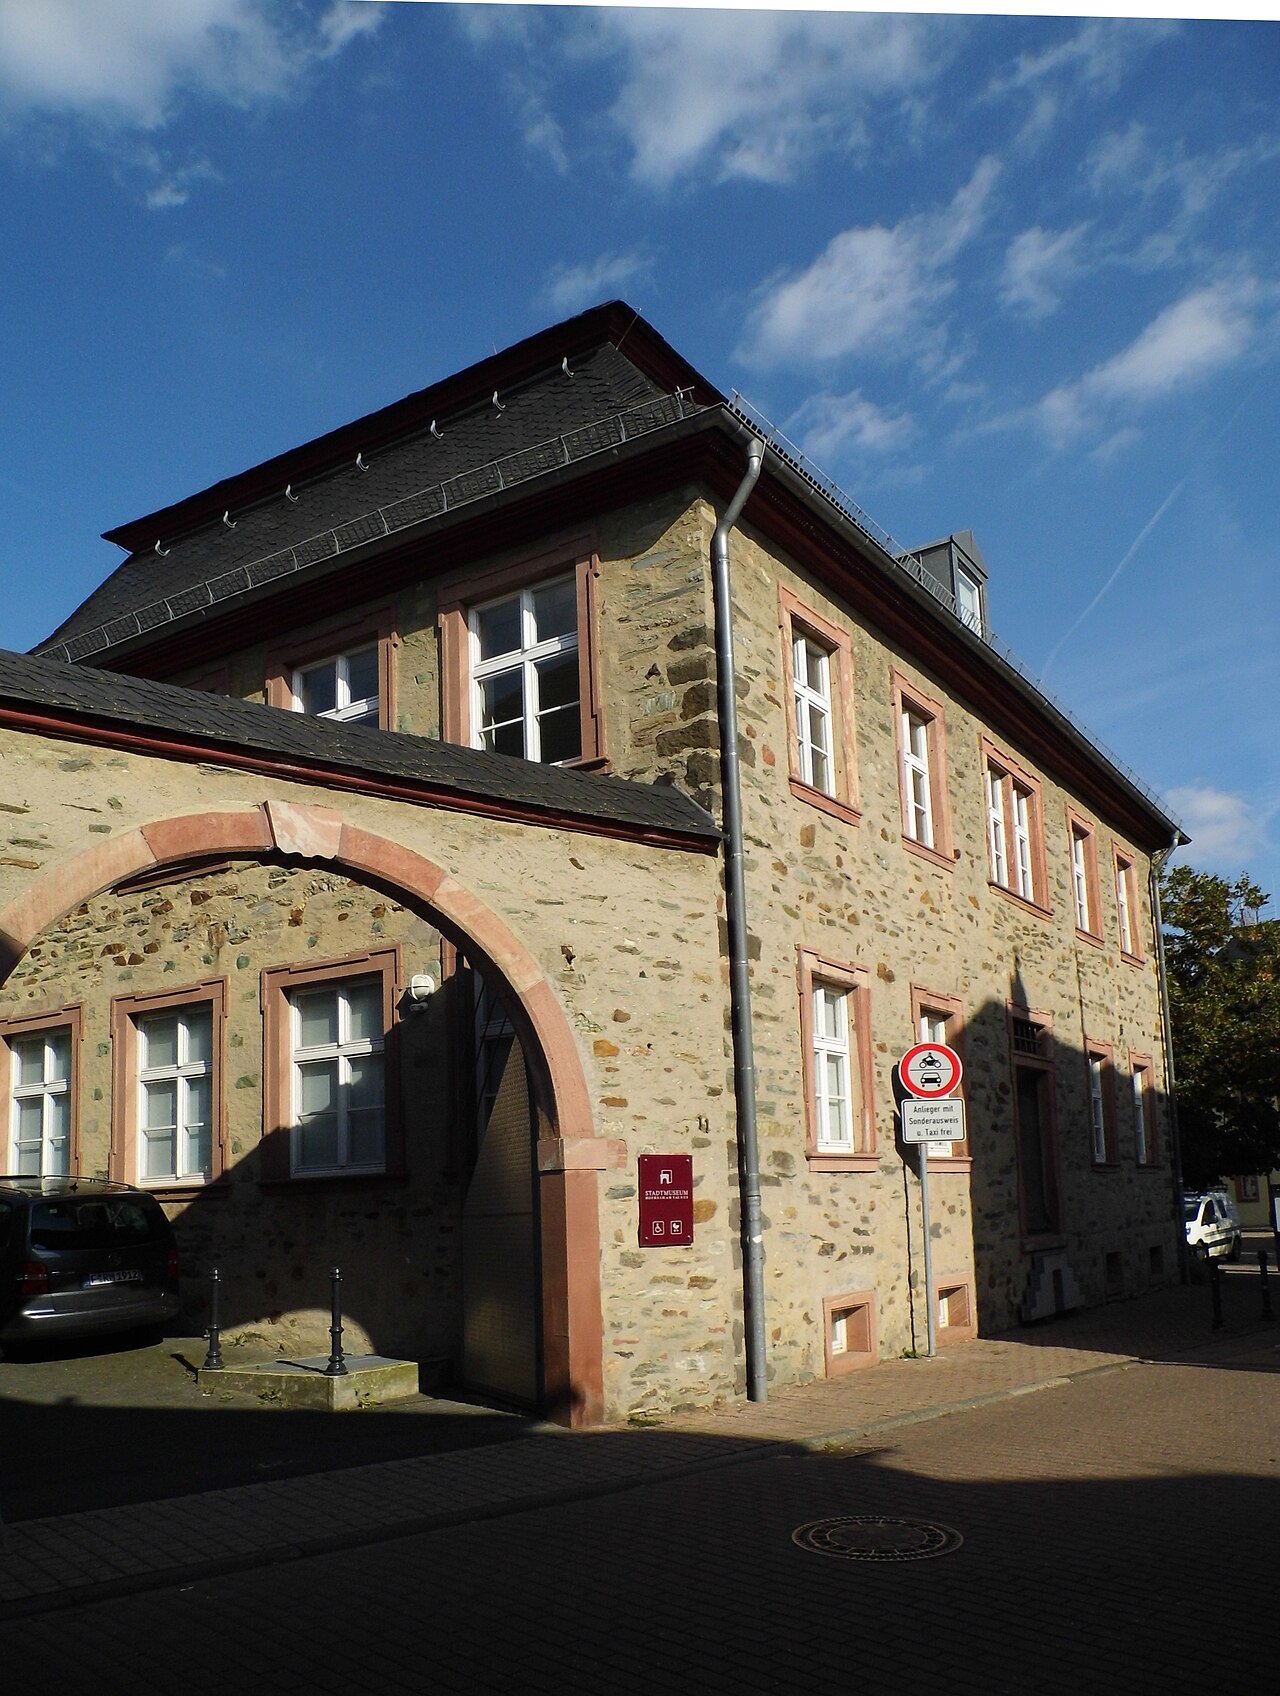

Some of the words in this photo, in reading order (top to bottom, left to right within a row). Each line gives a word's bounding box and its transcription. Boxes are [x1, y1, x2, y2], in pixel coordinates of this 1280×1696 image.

[913, 1106, 941, 1114] Anlieger
[909, 1117, 959, 1125] Sonderausweis
[925, 1128, 939, 1136] Taxi
